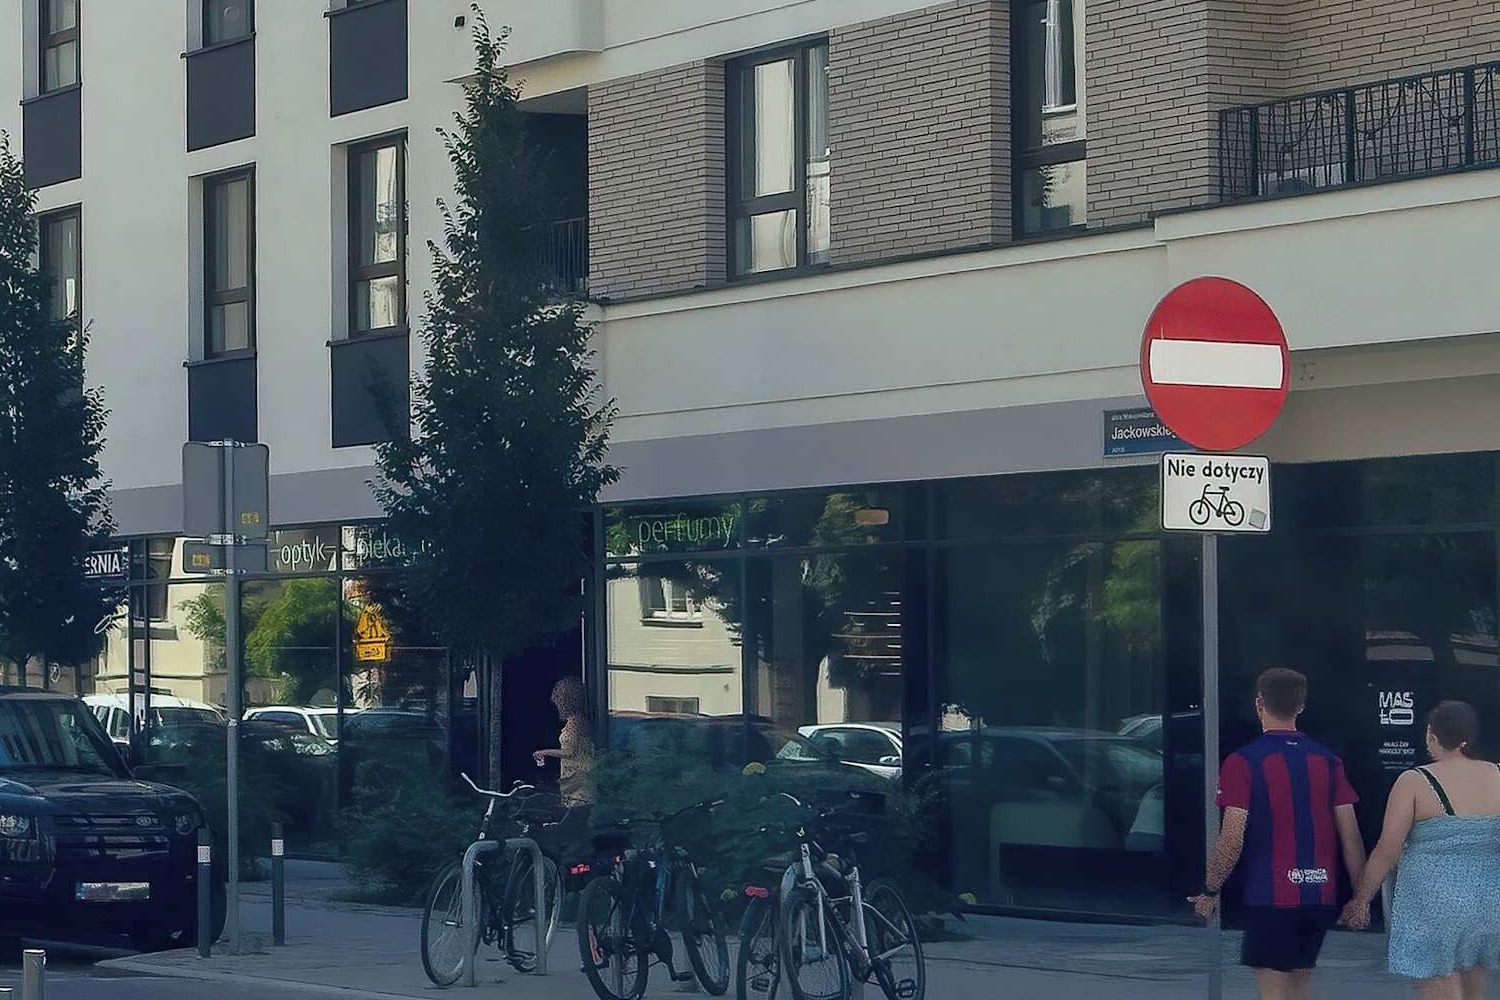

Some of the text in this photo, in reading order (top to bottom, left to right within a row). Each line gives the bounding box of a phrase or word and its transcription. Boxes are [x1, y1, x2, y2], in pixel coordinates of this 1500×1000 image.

[1167, 459, 1264, 484] Nie dotyczy
[638, 512, 734, 552] perfumy
[84, 553, 121, 575] ERNIA
[281, 535, 326, 571] optyk
[357, 531, 406, 567] pieka
[1379, 691, 1414, 708] MAS
